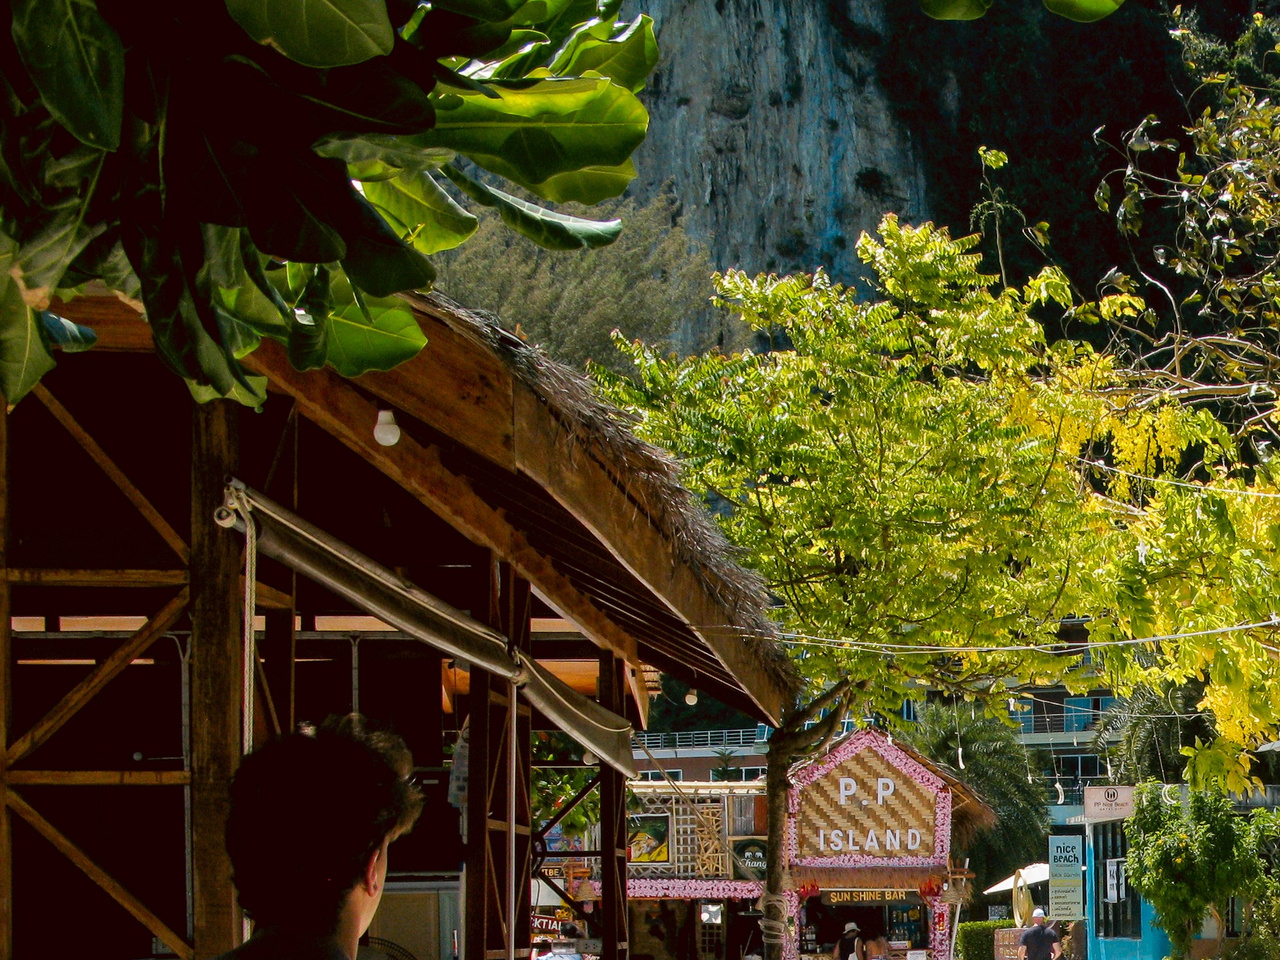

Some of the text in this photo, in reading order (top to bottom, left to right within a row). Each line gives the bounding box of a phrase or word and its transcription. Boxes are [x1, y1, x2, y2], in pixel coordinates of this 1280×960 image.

[819, 829, 921, 850] ISLAND
[1056, 843, 1076, 853] nice
[830, 891, 906, 902] SUN SHINE BAR
